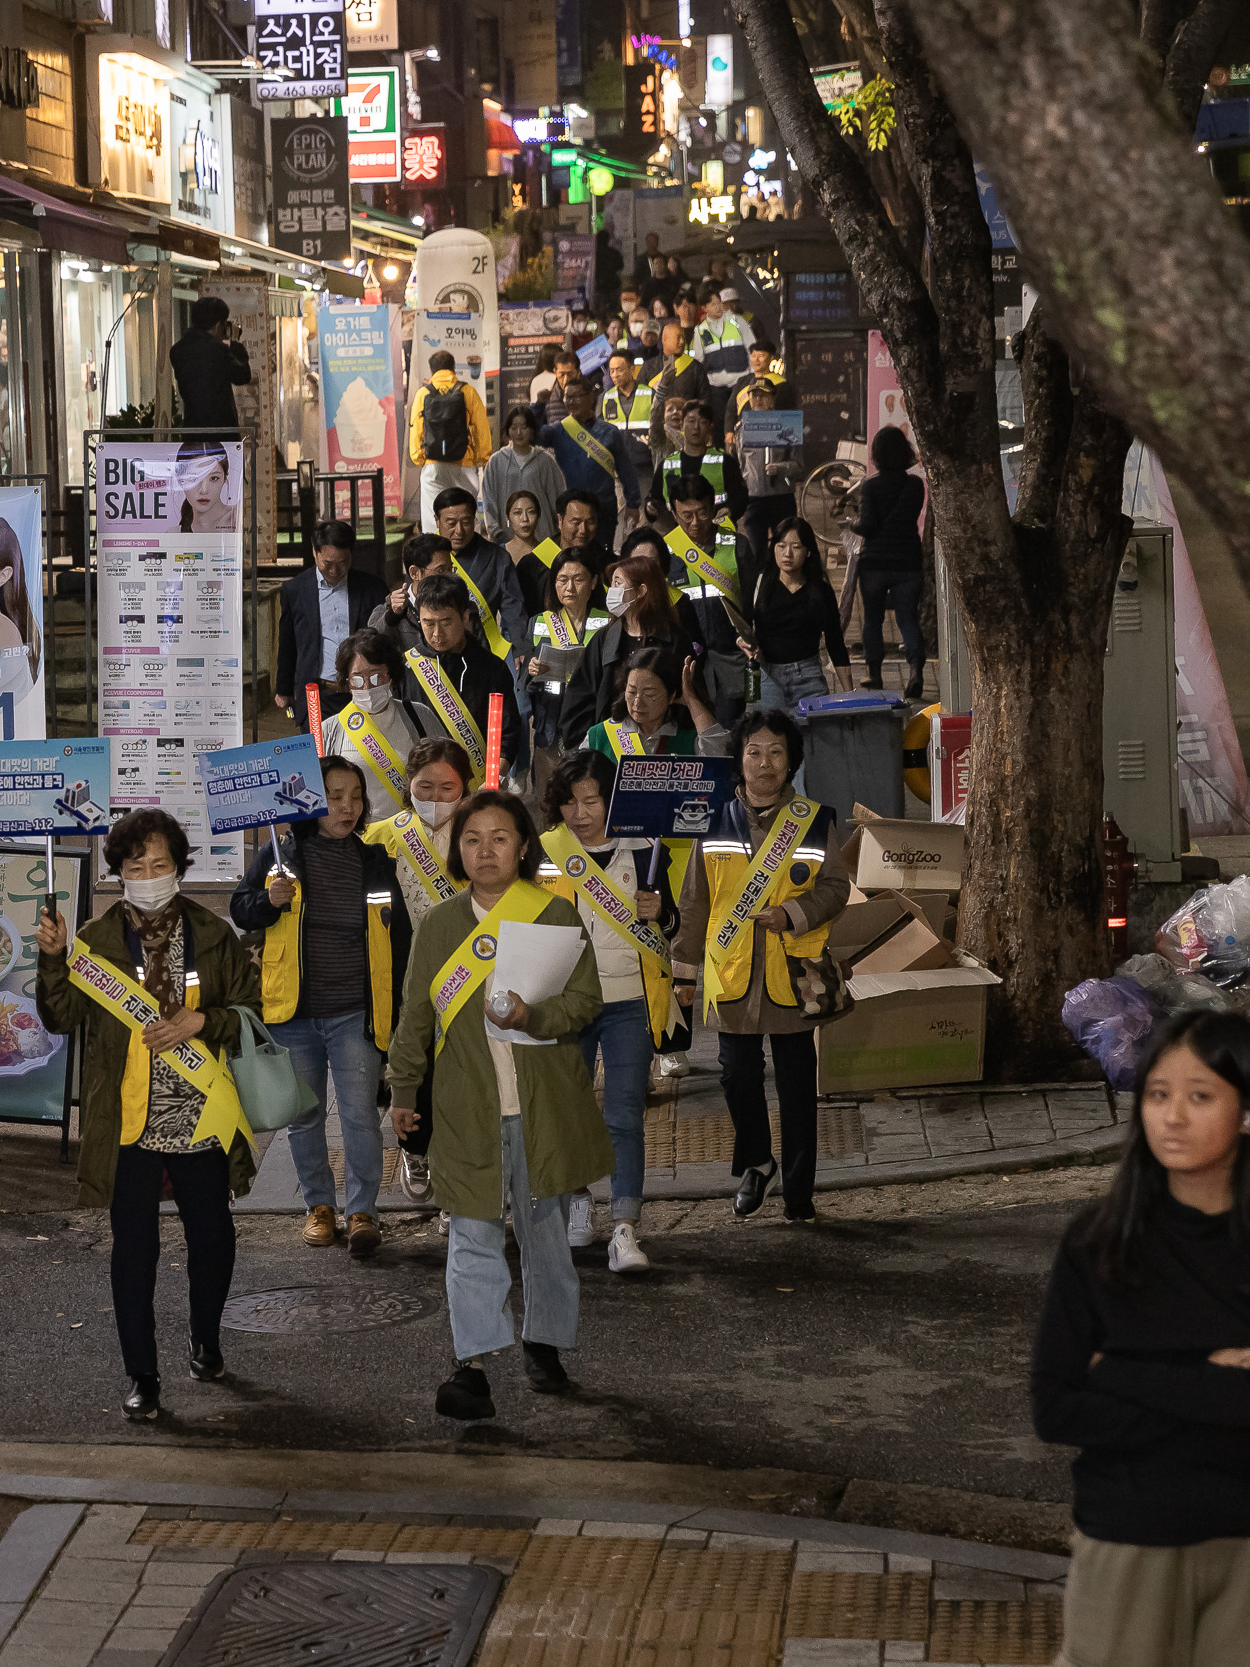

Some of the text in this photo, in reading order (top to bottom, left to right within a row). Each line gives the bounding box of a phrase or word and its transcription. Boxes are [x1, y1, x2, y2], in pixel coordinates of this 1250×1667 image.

[258, 13, 341, 46] 스시오
[258, 43, 342, 79] 건대점
[259, 83, 341, 98] 02 463 5955
[292, 133, 327, 150] EPIC
[293, 153, 327, 170] PLAN
[403, 135, 443, 181] 꽃
[277, 205, 347, 234] 방탈출
[688, 195, 736, 225] 사주
[302, 238, 322, 257] B1
[471, 254, 489, 275] 2F
[335, 316, 372, 331] 요거트
[324, 330, 384, 347] 아이스크림
[104, 457, 146, 487] BIG
[104, 491, 168, 520] SALE
[417, 656, 444, 698] 안전하고
[361, 733, 393, 771] 범죄없는
[14, 774, 43, 789] 안전과
[622, 761, 703, 779] 건대맛의 거리!
[208, 778, 235, 795] 청춘에
[234, 774, 261, 788] 안전과
[619, 780, 643, 792] 청춘에
[643, 780, 667, 792] 안전과
[33, 817, 55, 831] 112
[258, 808, 278, 821] 112
[402, 826, 440, 878] 범죄없는
[881, 850, 942, 865] GongZoo
[716, 817, 800, 950] 범죄없는 건대맛의 거리
[582, 874, 633, 925] 범죄없는
[434, 963, 473, 1012] 범죄없는
[70, 954, 128, 1002] 범죄없는
[171, 1040, 206, 1072] 거리
